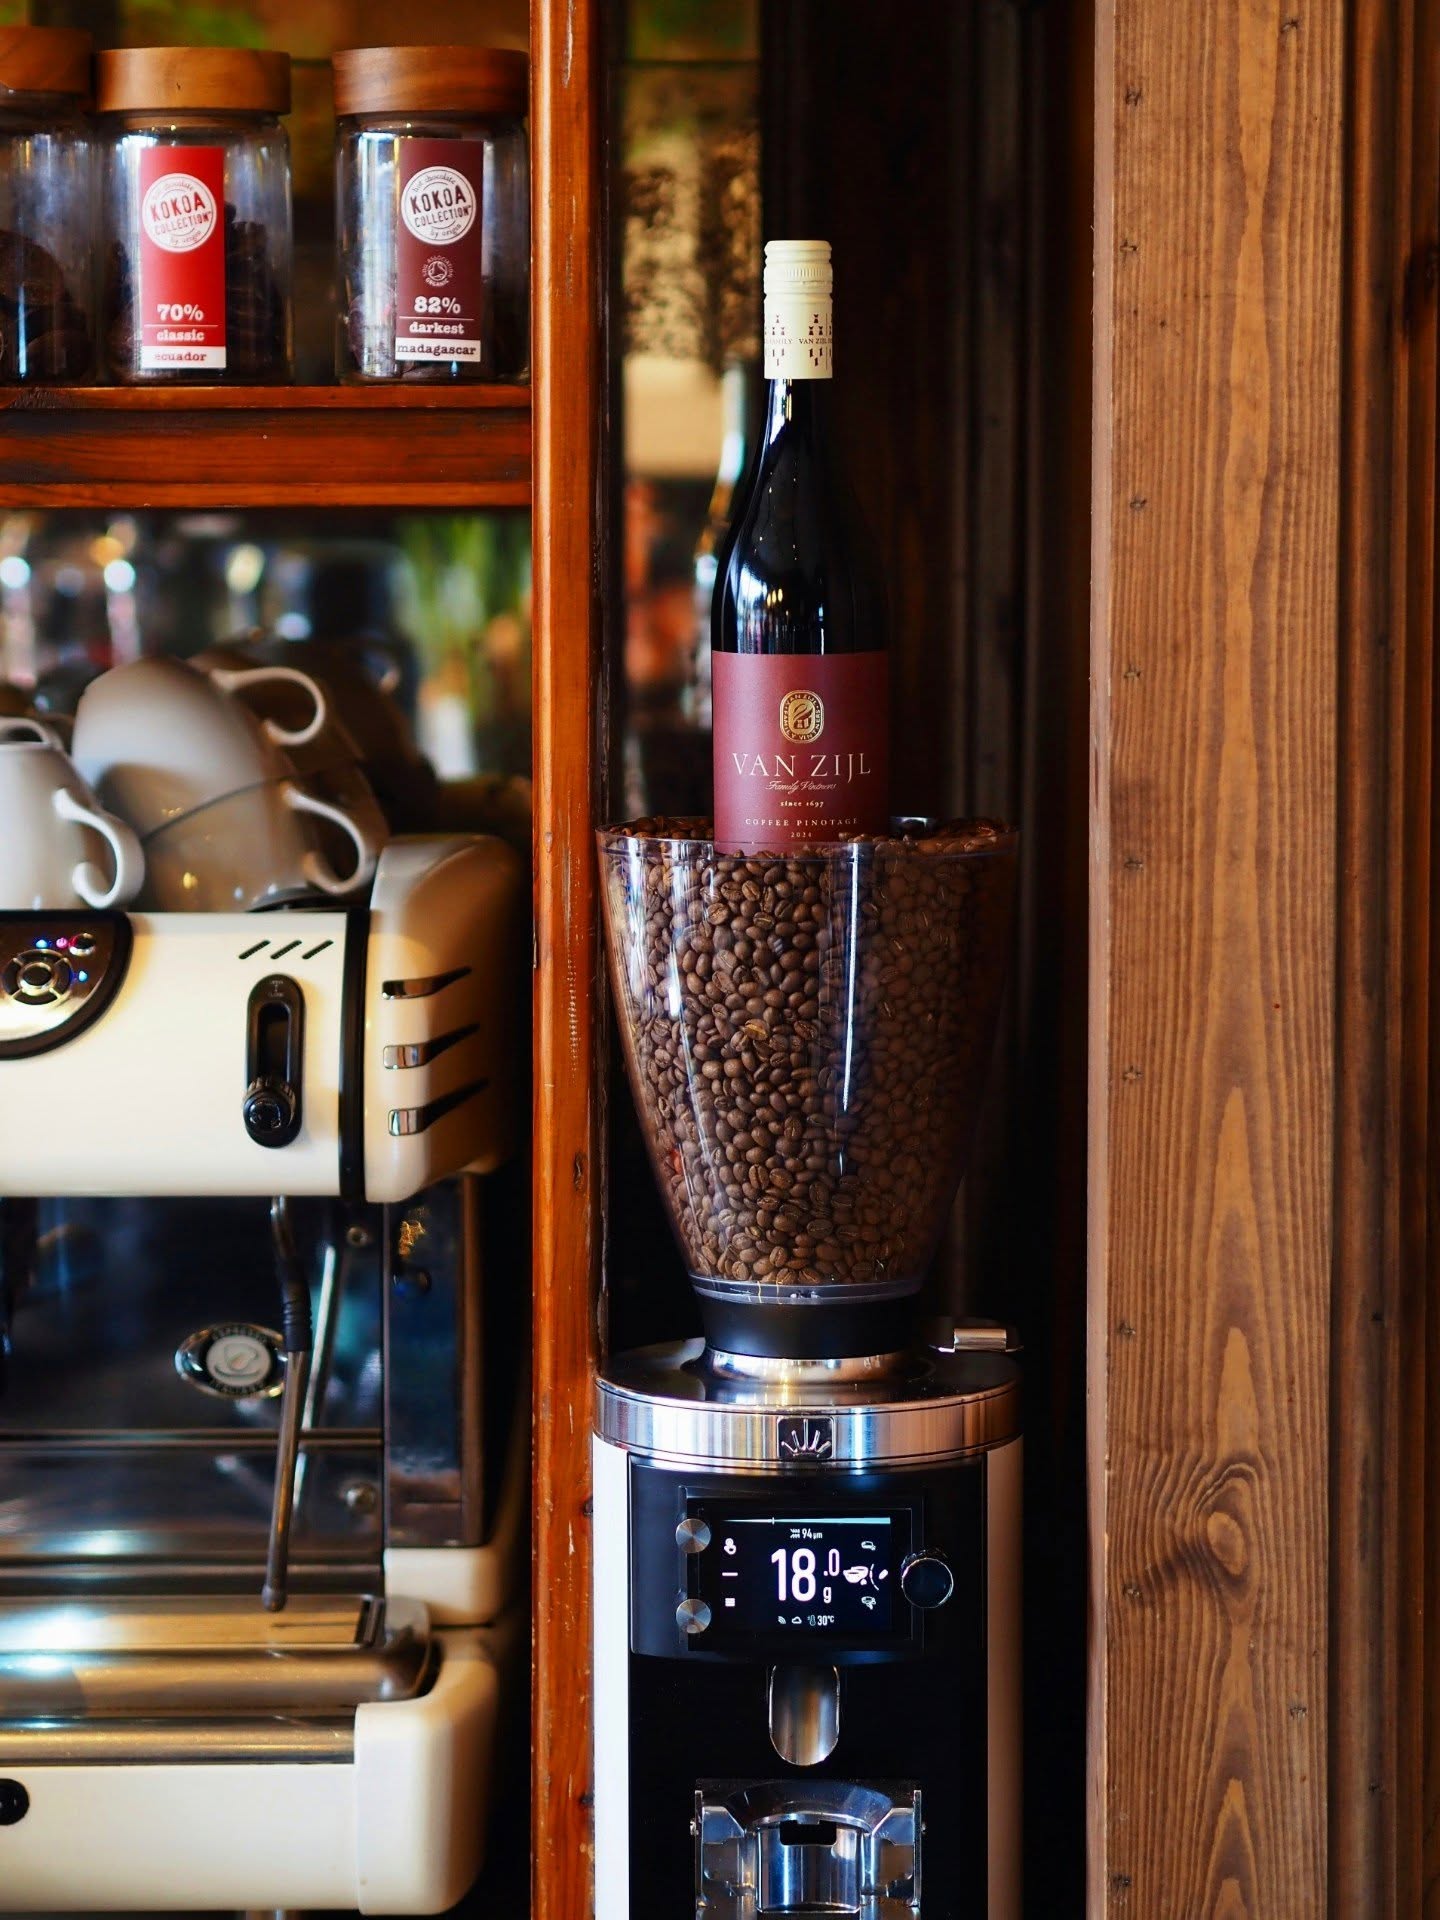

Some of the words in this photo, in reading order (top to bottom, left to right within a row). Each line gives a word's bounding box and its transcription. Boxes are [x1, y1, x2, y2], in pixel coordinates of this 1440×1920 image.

[150, 191, 206, 222] KOKOA
[410, 184, 467, 215] KOKOA
[156, 303, 205, 321] 70%
[413, 296, 461, 314] 82%
[156, 329, 205, 342] classic
[409, 321, 465, 335] darkest
[154, 351, 207, 361] ecuador
[396, 343, 477, 357] madagascar
[732, 752, 796, 778] VAN
[810, 752, 871, 784] ZIJL
[765, 780, 800, 795] Family
[745, 818, 789, 827] COFFEE
[796, 817, 858, 827] PINOTAGE
[822, 1586, 832, 1604] g
[817, 1615, 835, 1626] 30°C
